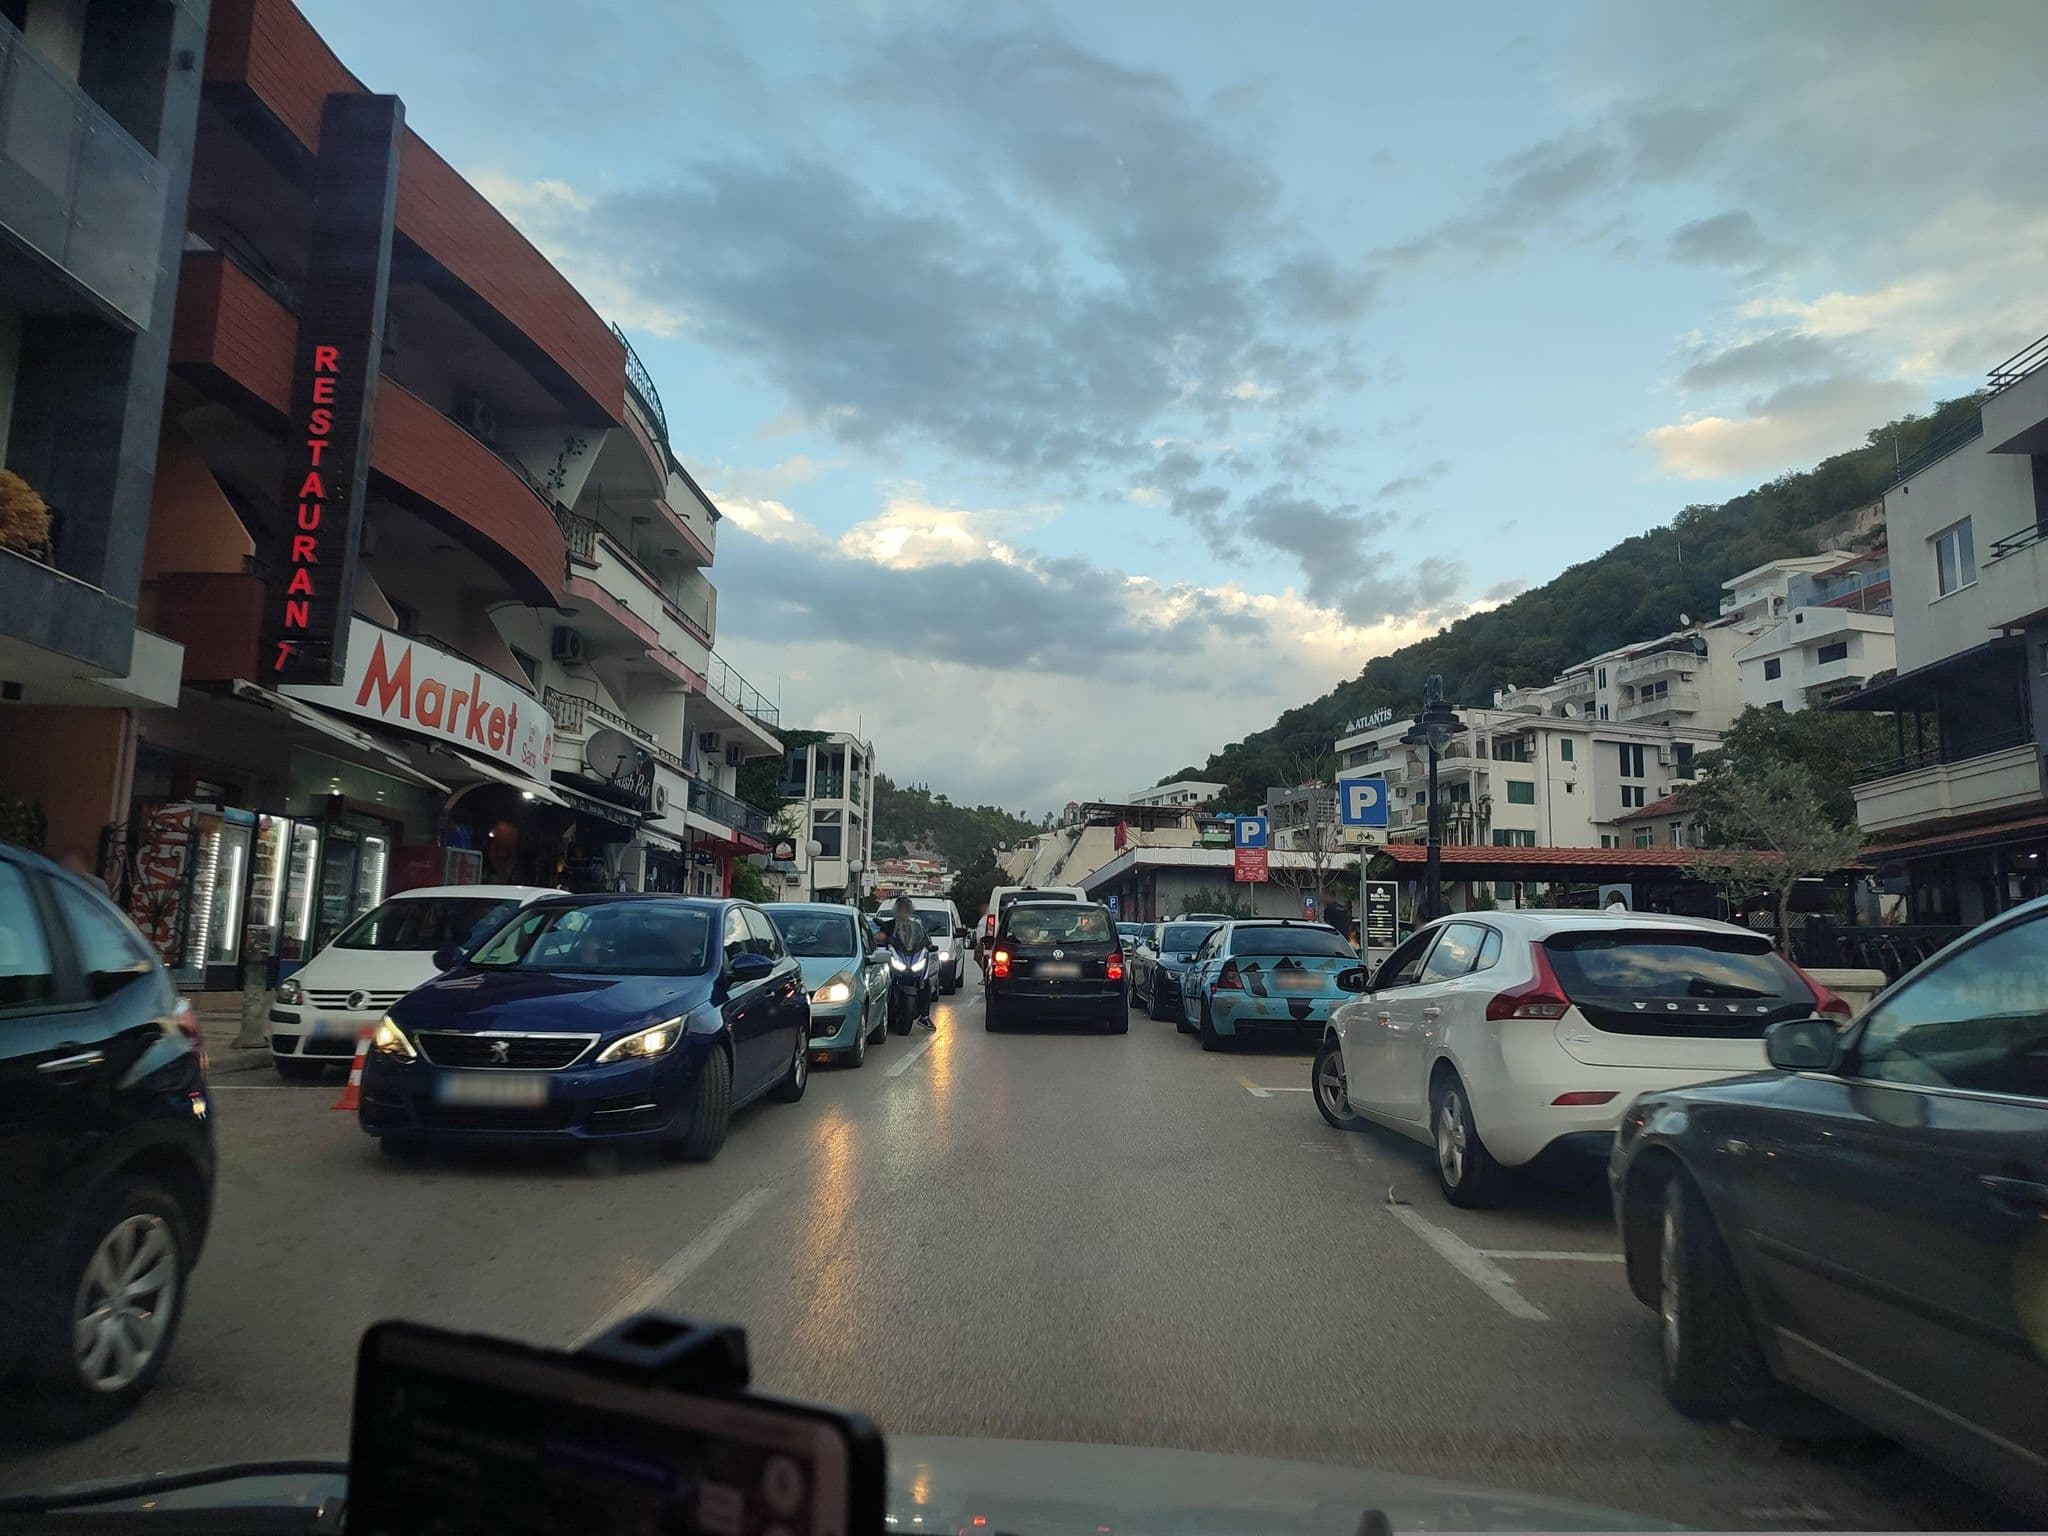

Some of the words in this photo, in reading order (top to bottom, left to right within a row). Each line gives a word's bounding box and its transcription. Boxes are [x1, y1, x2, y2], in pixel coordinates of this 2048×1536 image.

[273, 344, 340, 673] RESTAURANT
[354, 631, 518, 756] Market
[1355, 708, 1393, 730] ATLANTIS
[1349, 785, 1378, 819] P
[1241, 821, 1260, 844] P
[1632, 1001, 1769, 1013] VOLVO
